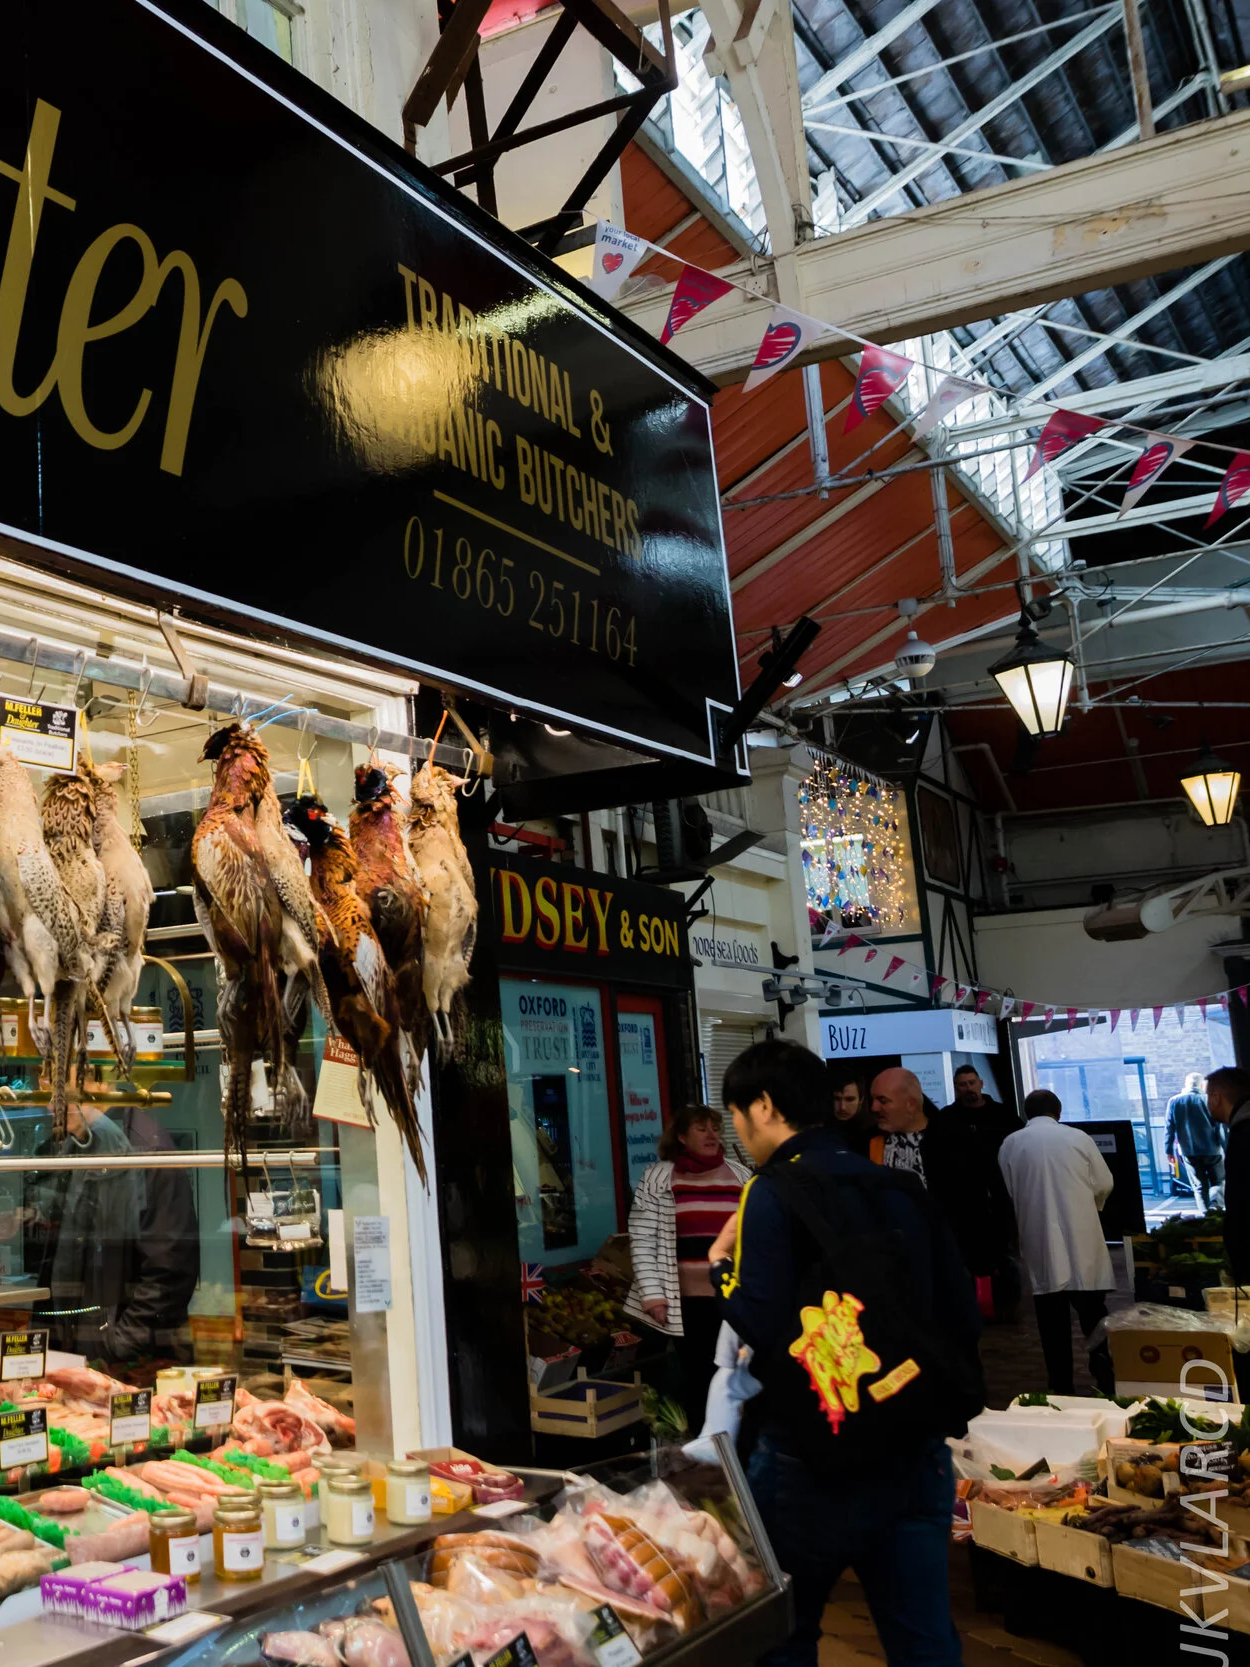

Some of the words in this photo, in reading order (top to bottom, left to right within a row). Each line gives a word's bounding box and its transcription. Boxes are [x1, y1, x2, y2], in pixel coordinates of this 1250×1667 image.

[601, 234, 639, 252] market
[604, 225, 623, 236] your
[623, 230, 641, 242] local
[398, 262, 581, 438] TRADITIONAL
[590, 389, 614, 457] &
[516, 434, 642, 561] BUTCHERS
[404, 516, 515, 617] 01865
[528, 570, 638, 668] 251164
[5, 701, 43, 717] M.FELLER
[6, 714, 40, 729] Daughter
[491, 867, 614, 956] DSEY
[619, 909, 634, 949] &
[639, 913, 680, 957] SON
[519, 995, 567, 1017] OXFORD
[520, 1019, 569, 1033] PRESERVATION
[521, 1035, 568, 1061] TRUST
[828, 1024, 867, 1051] BUZZ
[330, 1048, 357, 1063] Hagg
